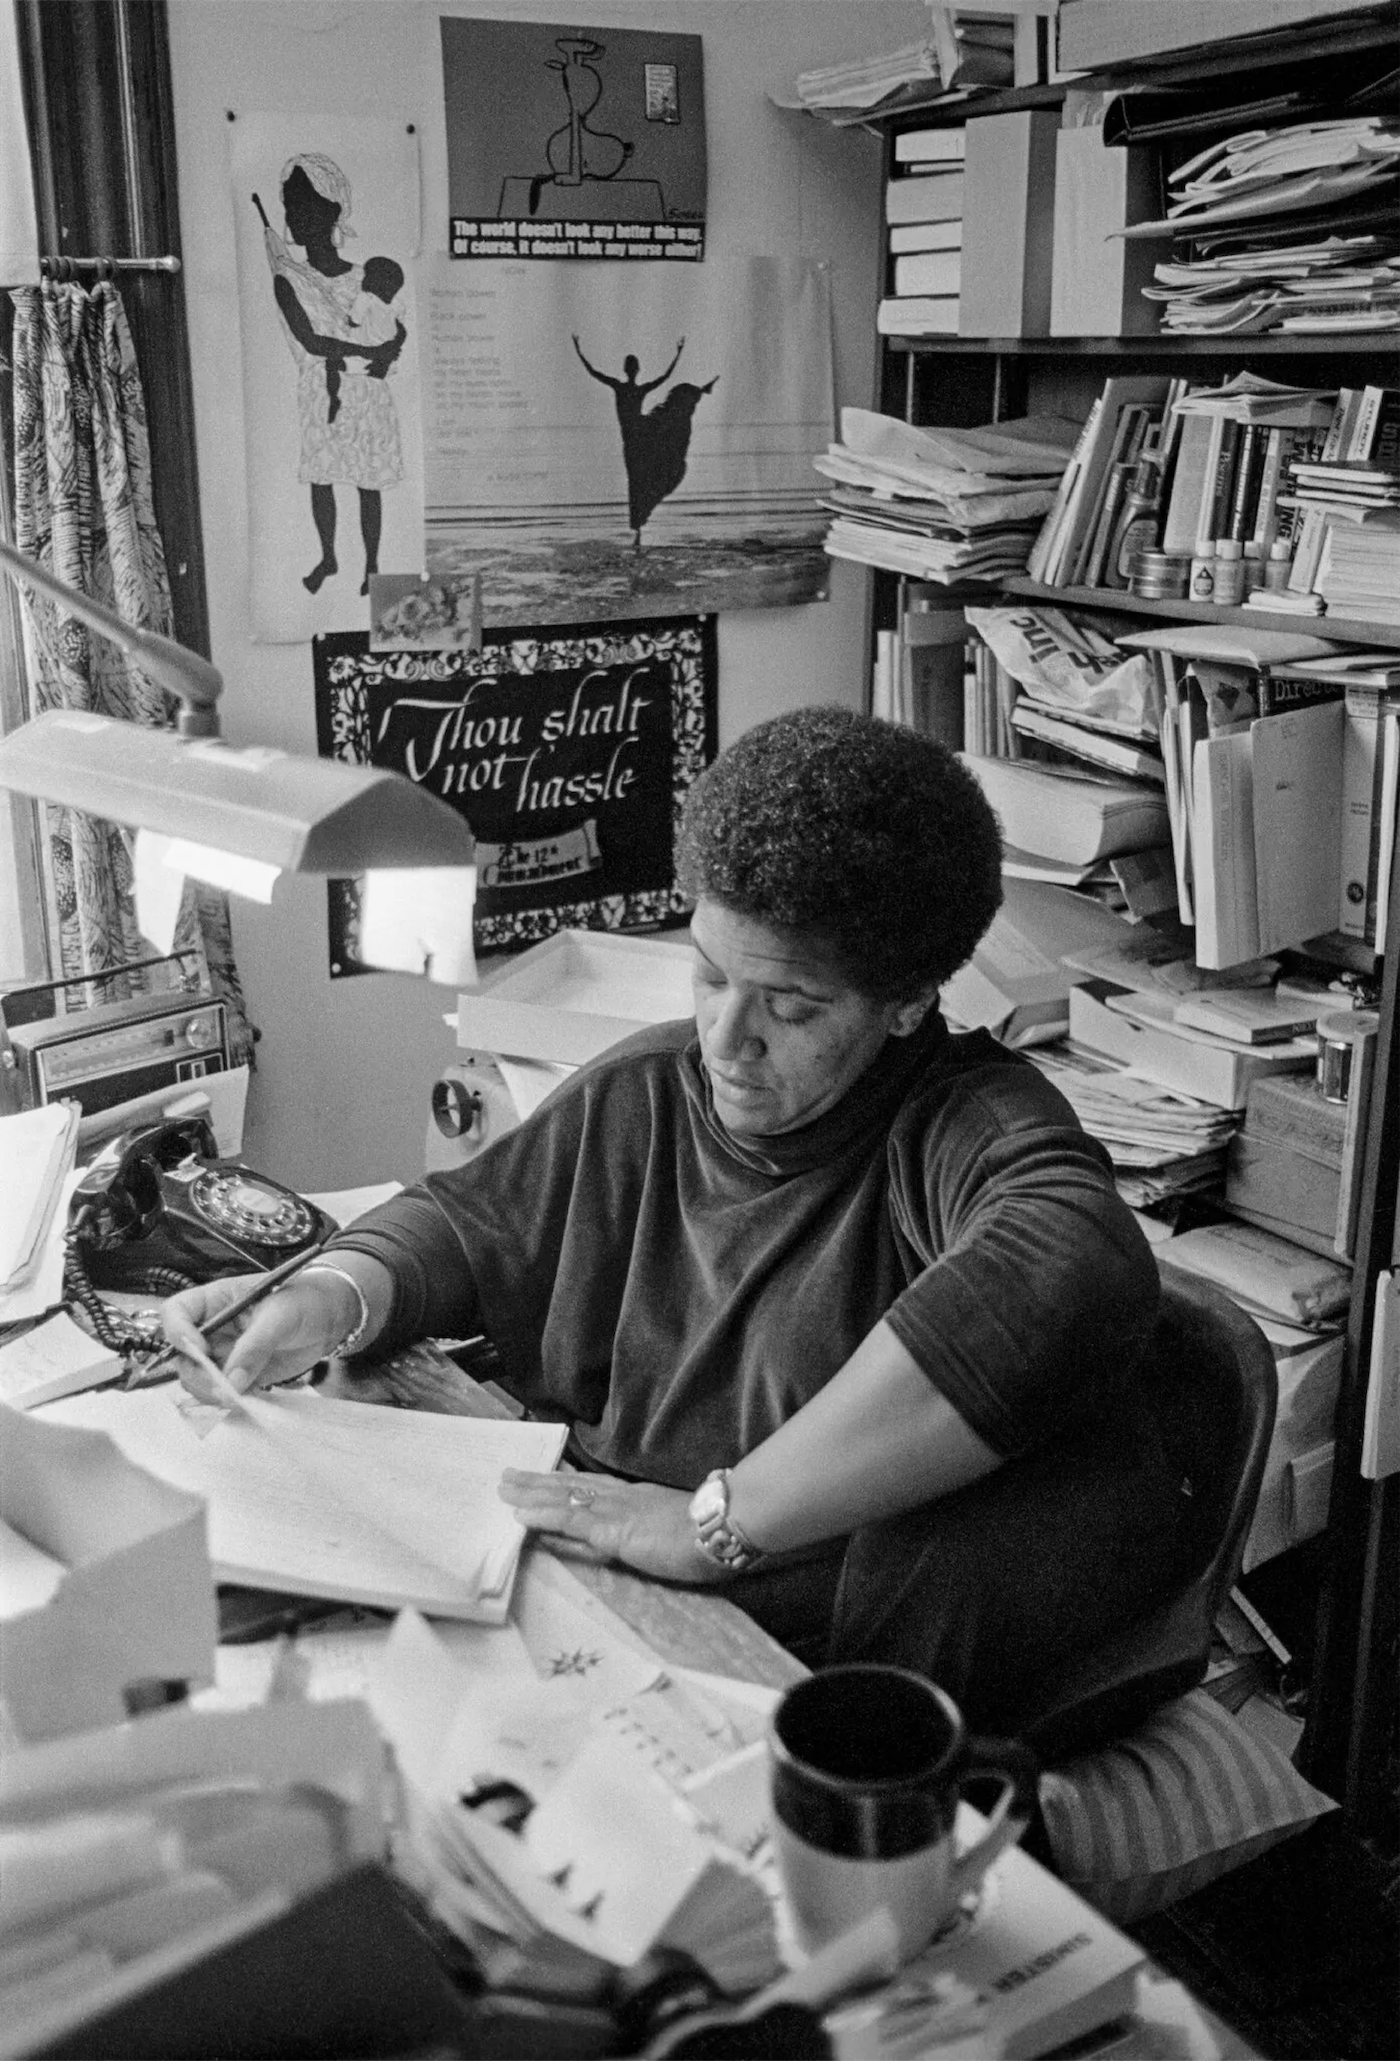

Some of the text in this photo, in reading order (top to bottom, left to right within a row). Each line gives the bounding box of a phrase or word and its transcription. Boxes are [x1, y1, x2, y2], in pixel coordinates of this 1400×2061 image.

[453, 220, 478, 236] The
[480, 221, 516, 237] world
[518, 221, 563, 238] doesn't
[565, 222, 591, 239] look
[592, 224, 615, 240] any
[616, 224, 651, 239] better
[654, 225, 676, 240] this
[453, 239, 468, 254] Of
[531, 240, 575, 255] doesn't
[577, 241, 603, 256] look
[605, 243, 627, 257] any
[628, 243, 662, 257] worse
[377, 667, 652, 782] Thou shalt
[442, 737, 640, 812] not hassle
